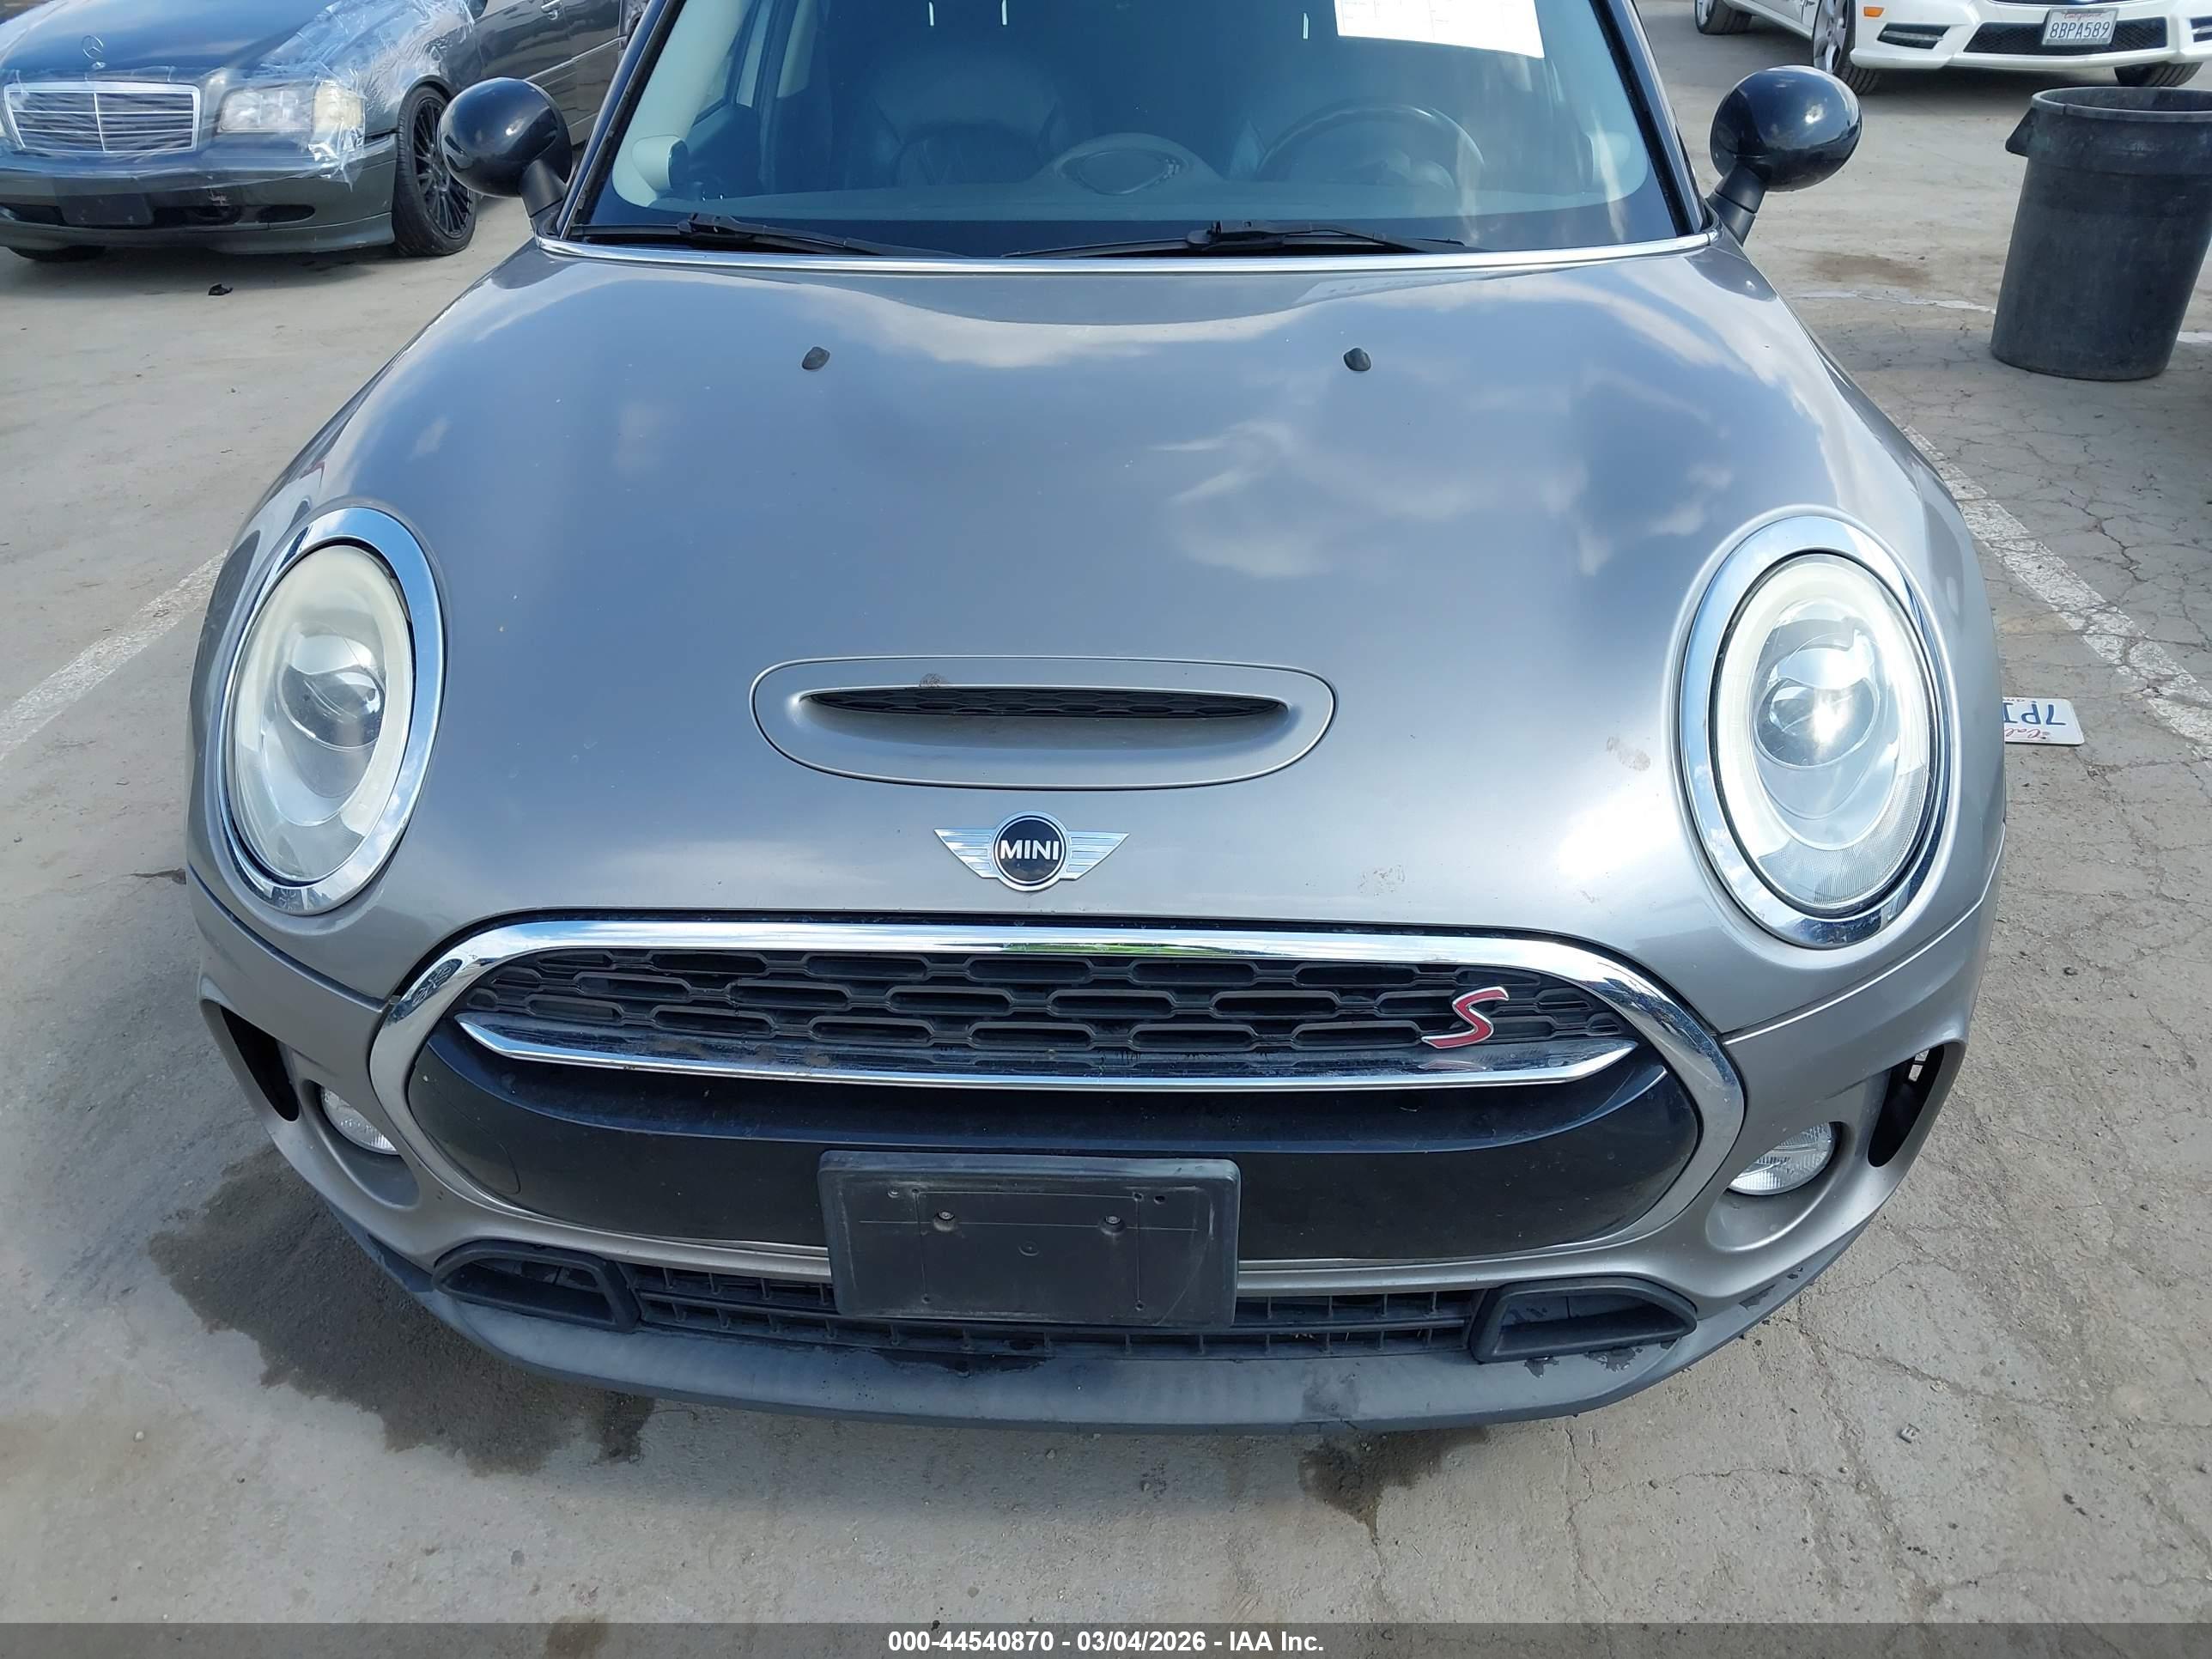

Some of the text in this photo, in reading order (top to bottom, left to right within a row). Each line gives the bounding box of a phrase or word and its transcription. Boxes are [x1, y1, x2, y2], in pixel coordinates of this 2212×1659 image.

[2050, 21, 2111, 39] 8BPA589
[1000, 839, 1060, 860] MINI
[1420, 985, 1510, 1049] S
